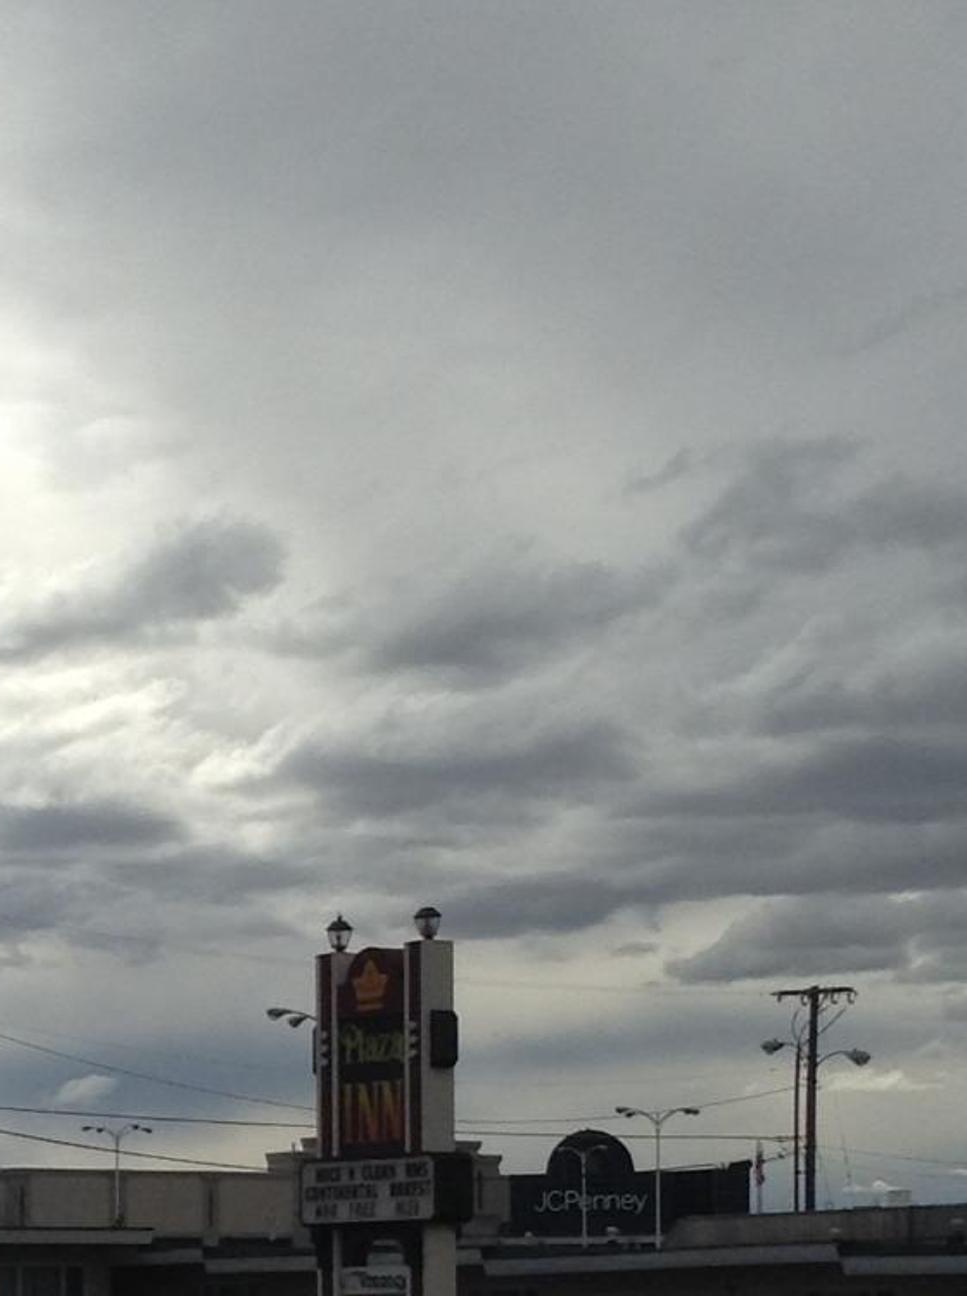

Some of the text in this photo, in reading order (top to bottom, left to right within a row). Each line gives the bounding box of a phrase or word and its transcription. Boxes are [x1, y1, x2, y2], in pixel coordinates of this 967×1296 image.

[340, 1024, 406, 1065] Plaza
[343, 1077, 403, 1142] INN
[305, 1183, 378, 1201] CONTINENTAL
[533, 1187, 649, 1215] JCPenney
